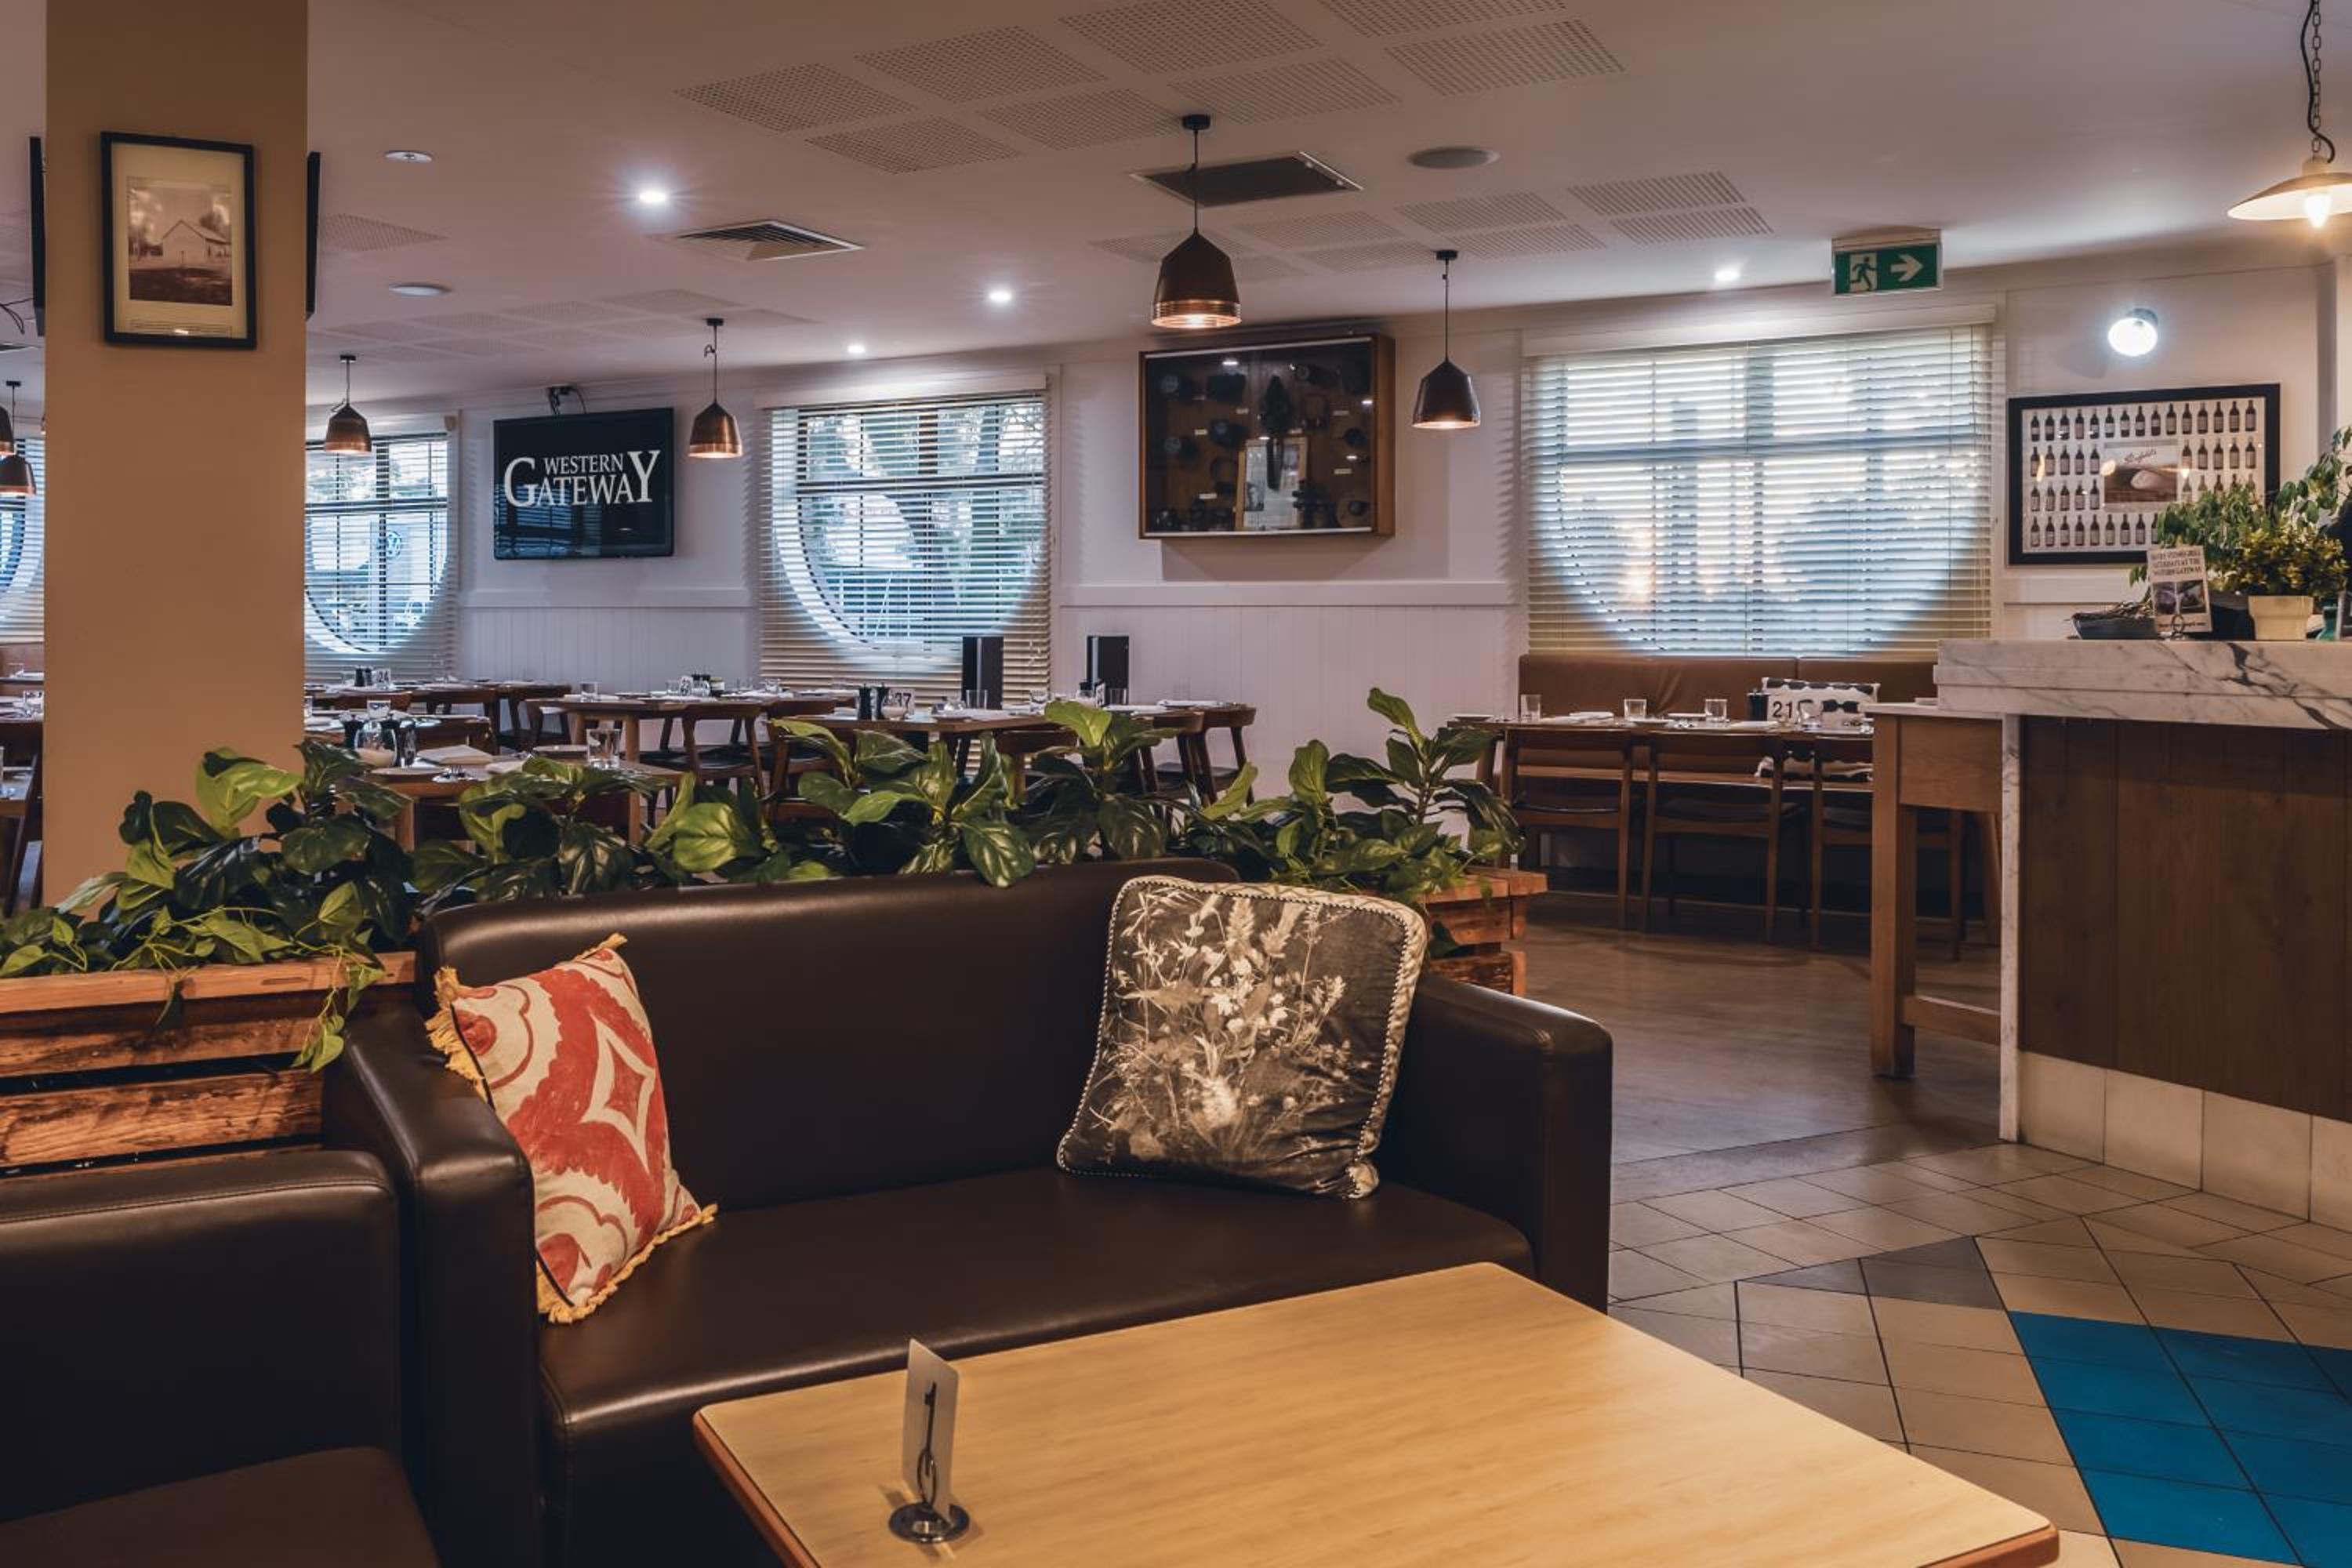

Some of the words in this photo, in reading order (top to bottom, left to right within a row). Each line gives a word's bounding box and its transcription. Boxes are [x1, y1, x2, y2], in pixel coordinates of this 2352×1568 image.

[544, 453, 623, 474] WESTERN
[504, 450, 661, 507] GATEWAY
[1773, 701, 1793, 719] 21
